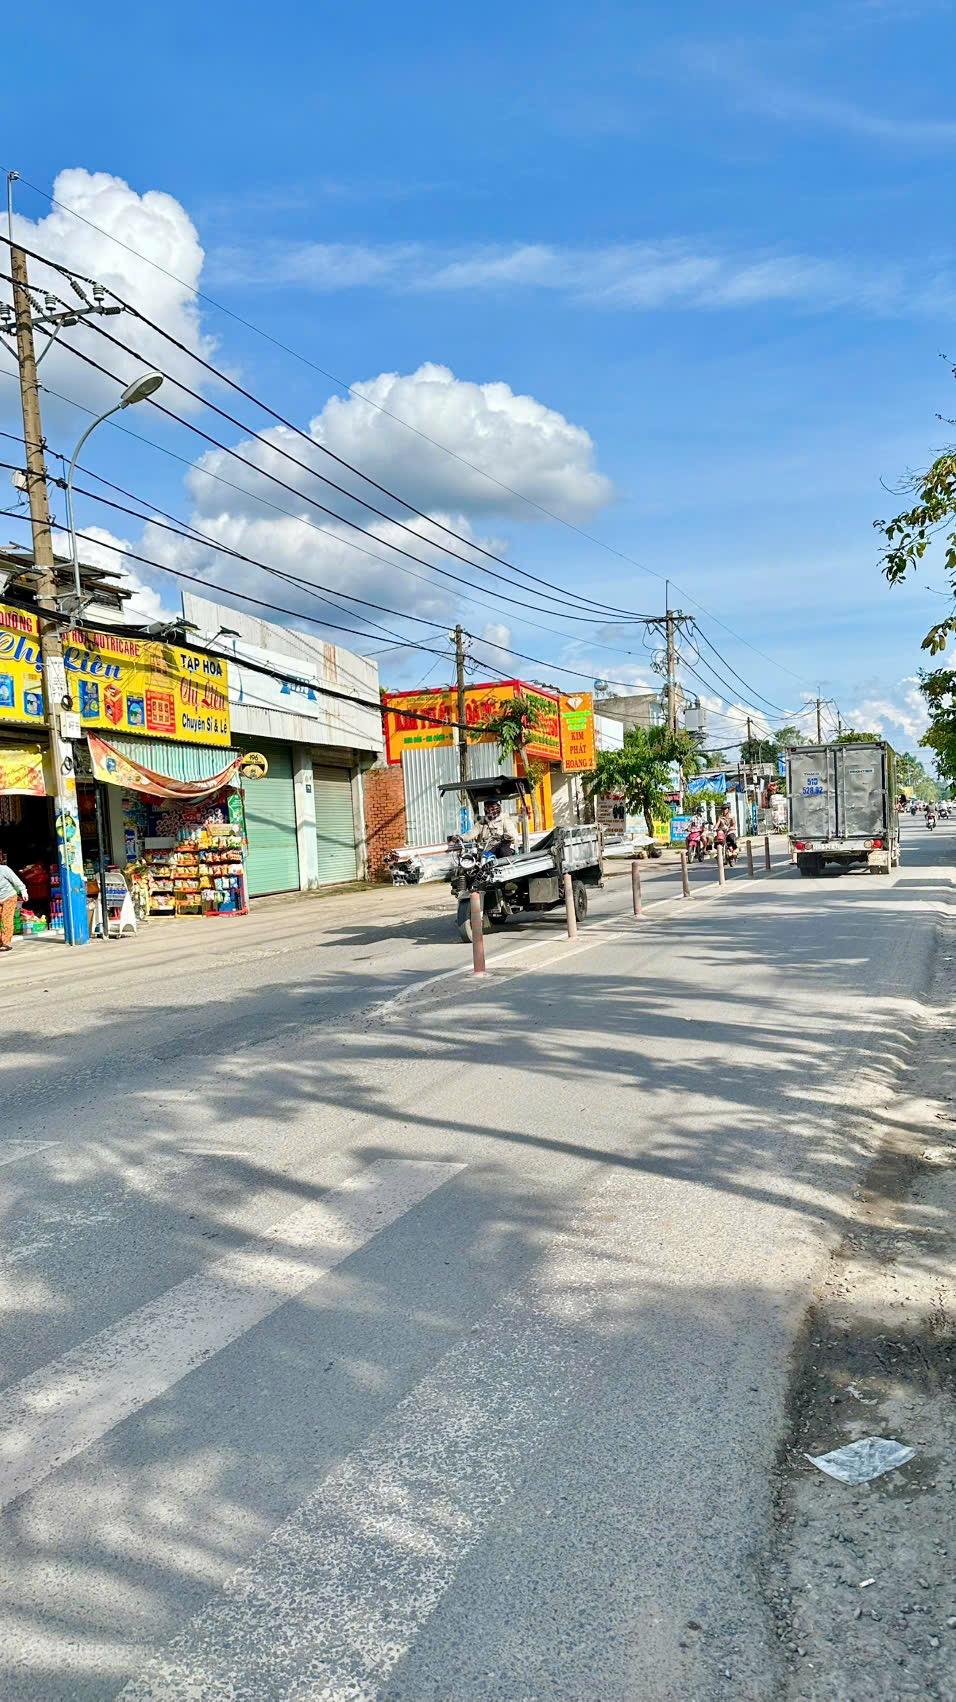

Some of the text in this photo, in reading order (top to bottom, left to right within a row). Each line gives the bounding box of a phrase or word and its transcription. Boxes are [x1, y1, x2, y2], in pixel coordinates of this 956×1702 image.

[94, 633, 140, 656] NUTRICARE
[63, 646, 121, 679] Liên
[182, 713, 205, 732] Chuyên
[214, 719, 219, 732] &
[571, 731, 584, 741] KIM
